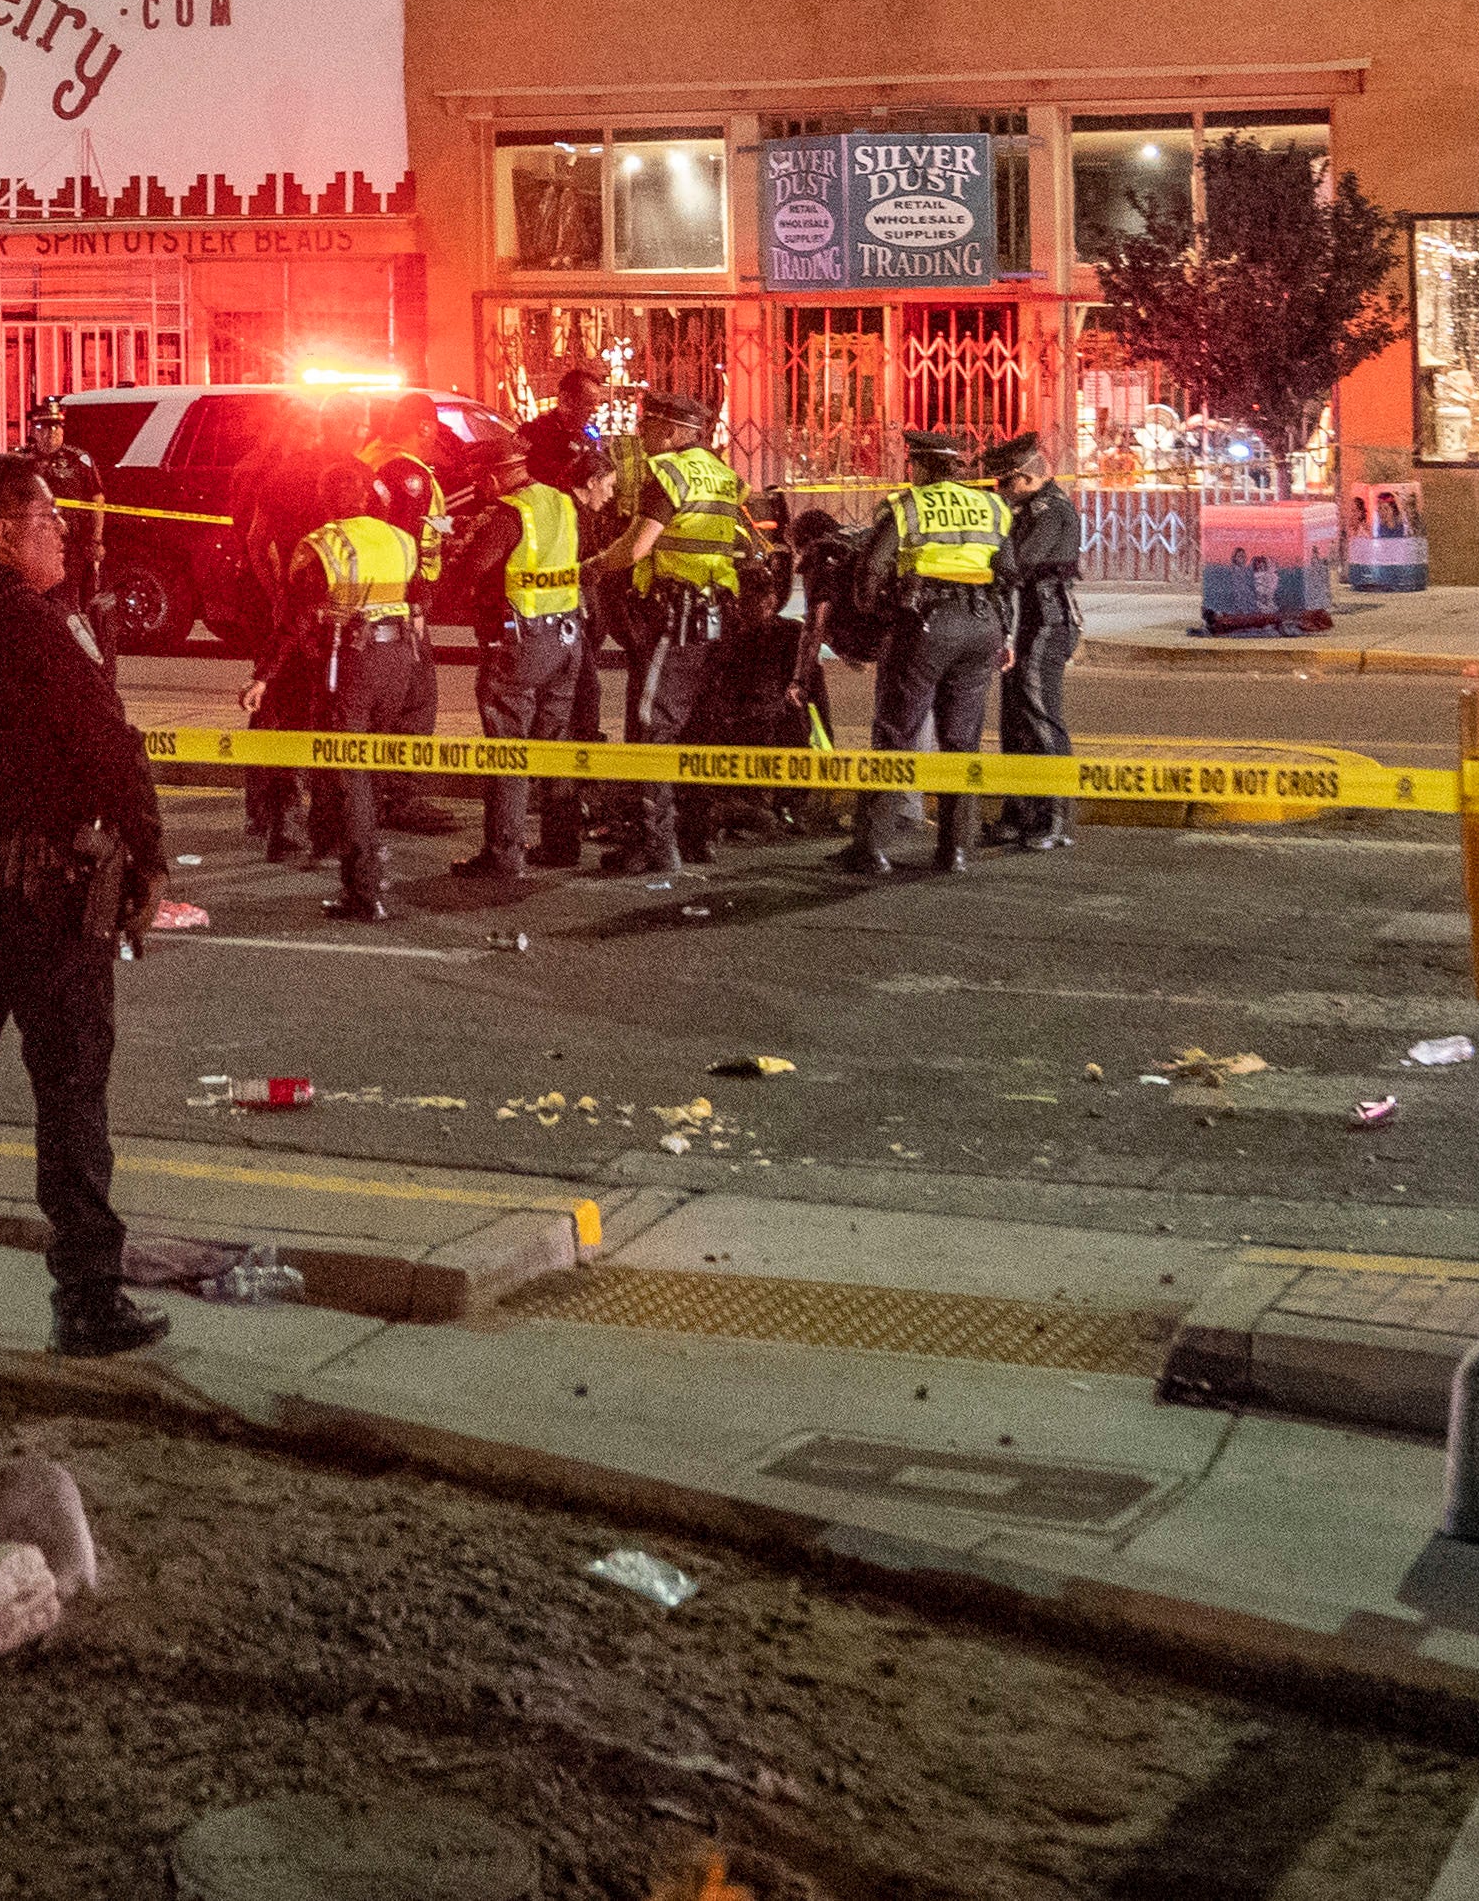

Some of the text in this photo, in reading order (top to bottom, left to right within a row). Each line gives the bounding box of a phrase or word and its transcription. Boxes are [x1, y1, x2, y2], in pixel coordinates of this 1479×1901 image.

[768, 149, 838, 180] SILVER
[853, 145, 982, 176] SILVER
[774, 172, 832, 206] DUST
[867, 168, 970, 202] DUST
[788, 204, 819, 214] RETAIL
[873, 214, 966, 225] WHOLESALE
[893, 199, 947, 210] RETAIL
[778, 219, 829, 229] WHOLESALE
[883, 229, 957, 240] SUPPLIES
[35, 233, 114, 255] SPINY
[122, 232, 236, 254] OYSTER
[254, 231, 354, 253] BEADS
[770, 246, 842, 281] TRADING
[856, 242, 984, 278] TRADING
[923, 508, 989, 529] POLICE
[312, 738, 528, 771] POLICE LINE DO NOT CROSS
[678, 752, 916, 784] POLICE LINE DO NOT CROSS
[1079, 765, 1340, 798] POLICE LINE DO NOT CROSS
